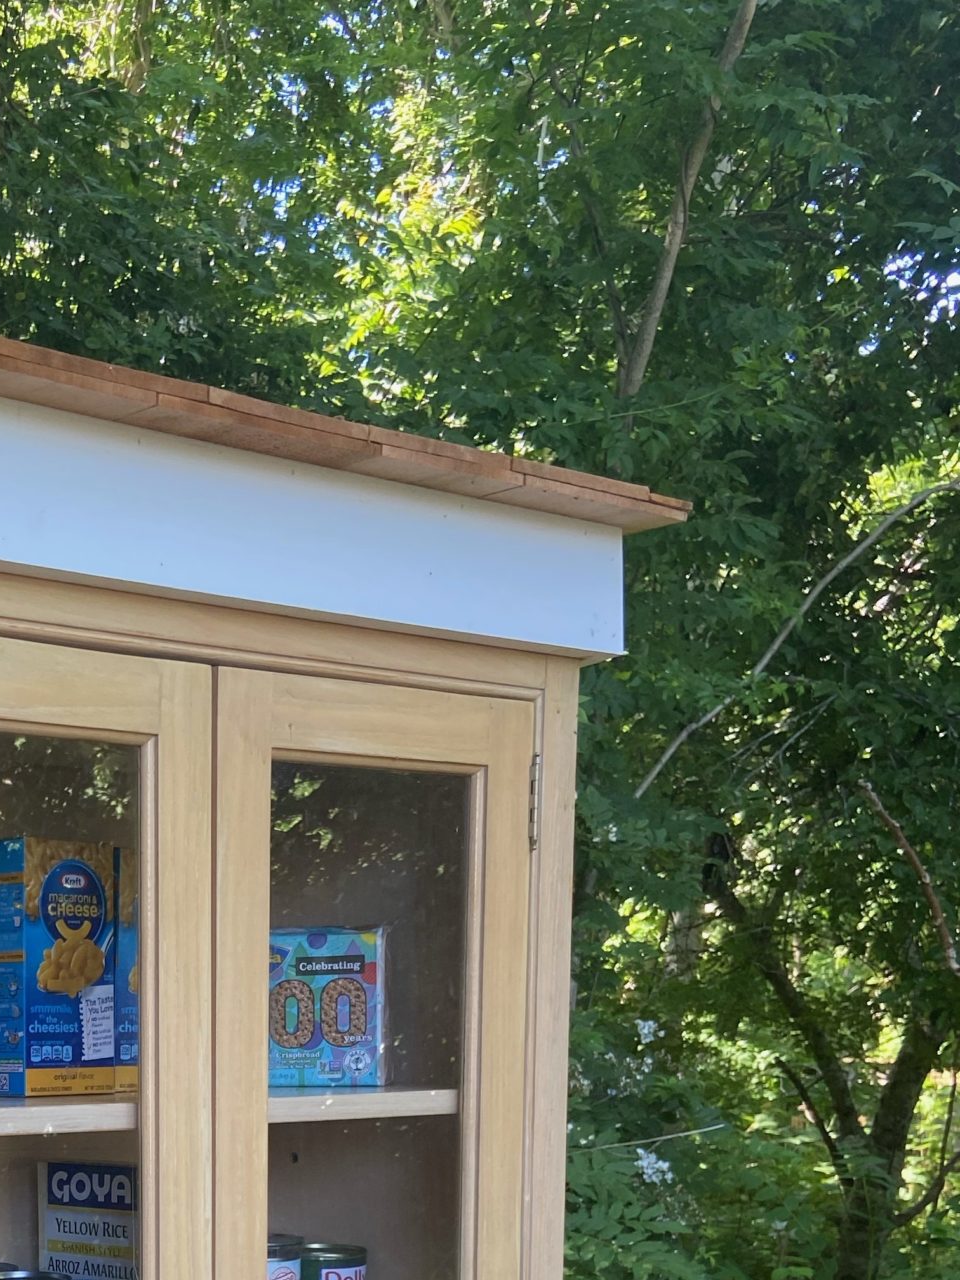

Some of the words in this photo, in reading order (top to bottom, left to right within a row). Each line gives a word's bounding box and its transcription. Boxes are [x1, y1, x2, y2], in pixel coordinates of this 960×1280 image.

[48, 893, 91, 903] macaroni
[299, 961, 362, 972] Celebrating
[29, 1020, 79, 1034] cheesiest
[343, 1034, 373, 1044] years
[51, 1171, 132, 1204] GOYA
[55, 1217, 100, 1237] YELLOW
[102, 1221, 129, 1239] RICE
[61, 1241, 96, 1253] SPANISH
[48, 1256, 80, 1275] ARROZ
